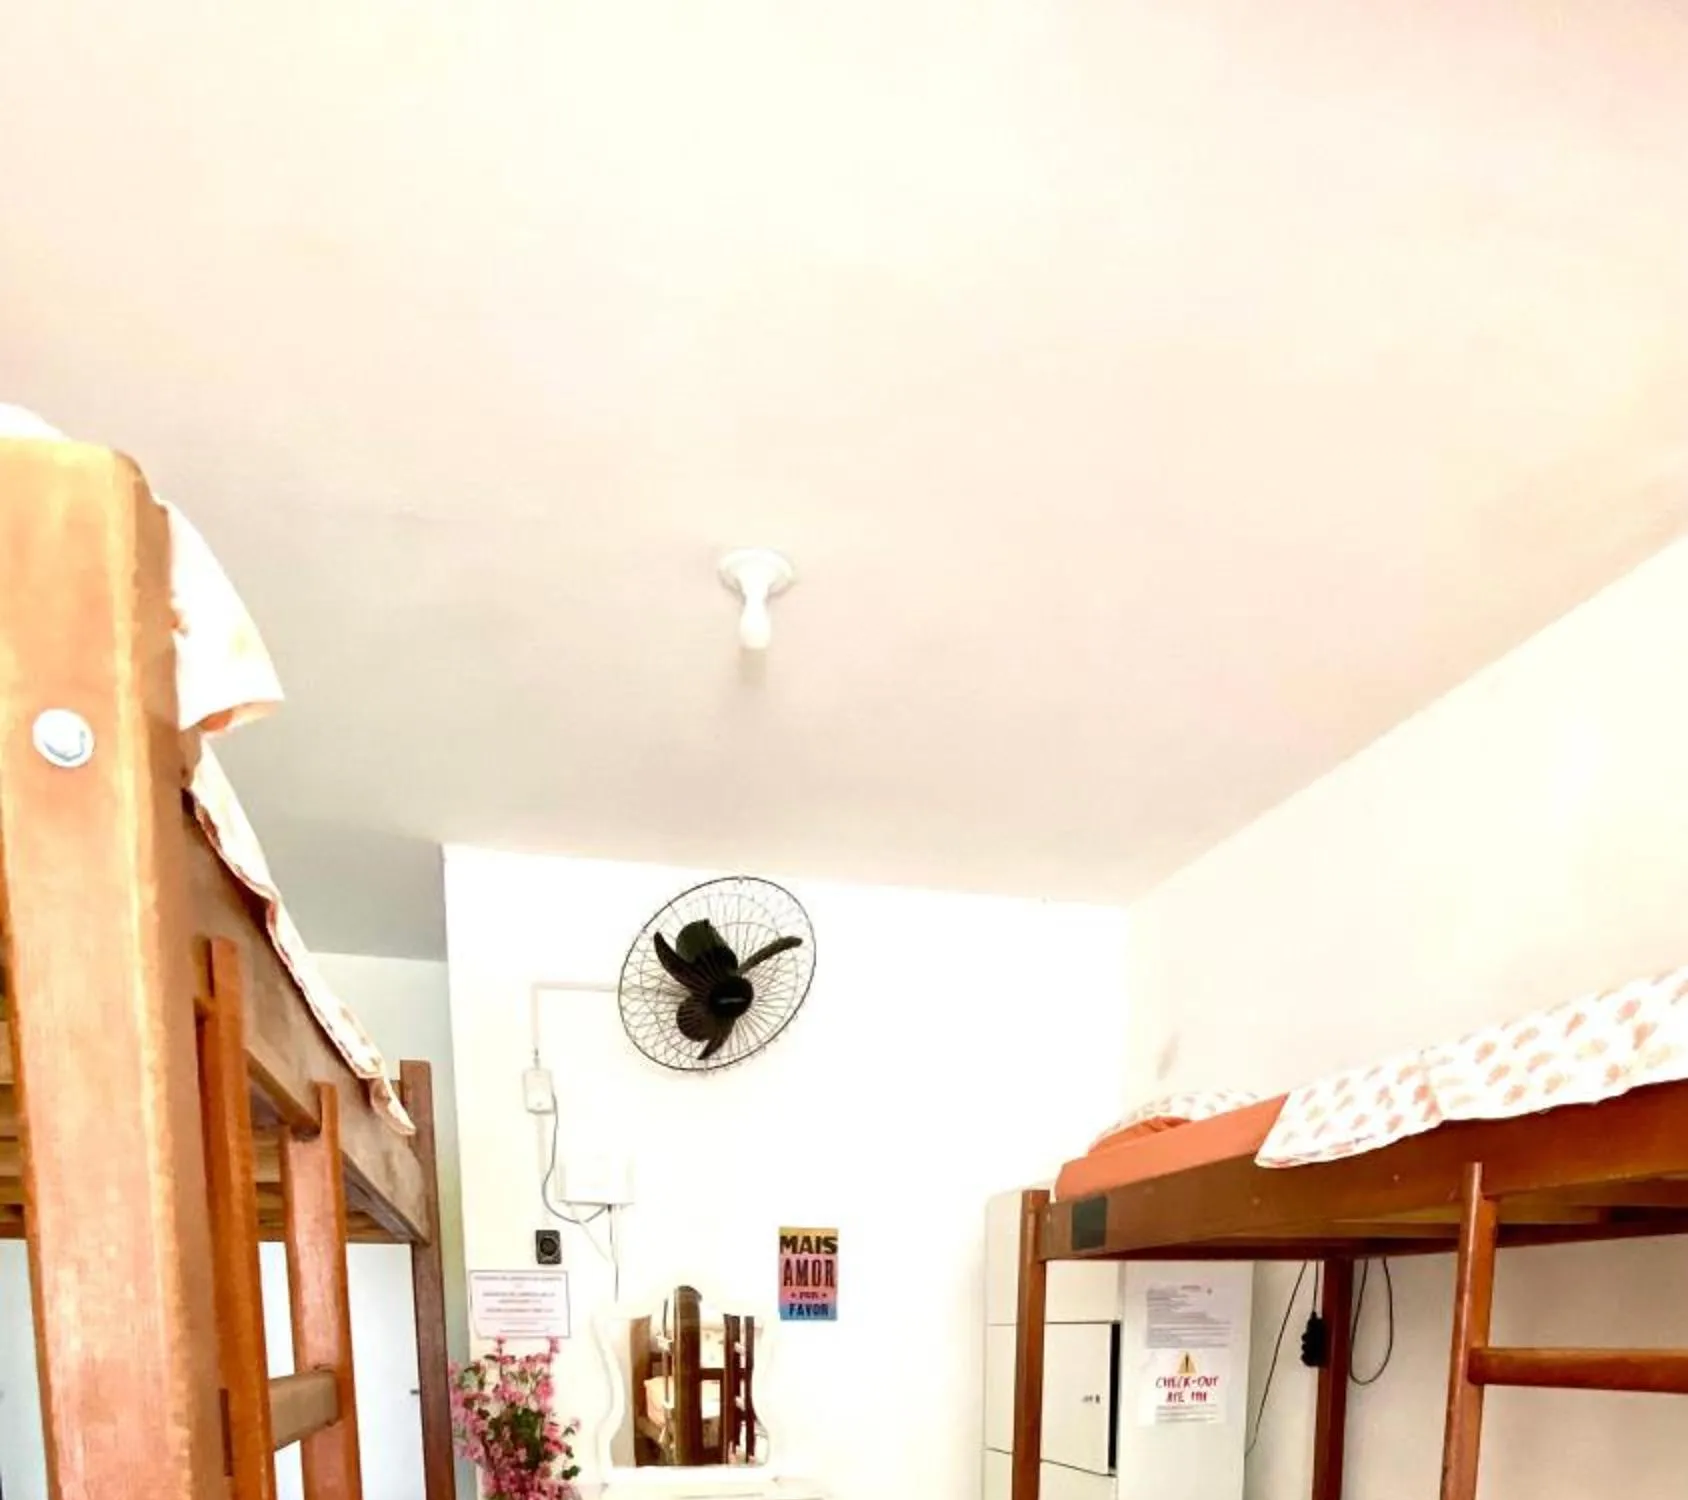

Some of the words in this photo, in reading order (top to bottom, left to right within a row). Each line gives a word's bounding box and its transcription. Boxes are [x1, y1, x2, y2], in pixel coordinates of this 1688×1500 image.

[780, 1235, 838, 1255] MAIS
[783, 1258, 835, 1288] AMOR
[788, 1303, 829, 1317] FAVOR
[1155, 1375, 1220, 1389] CHECK-OUT
